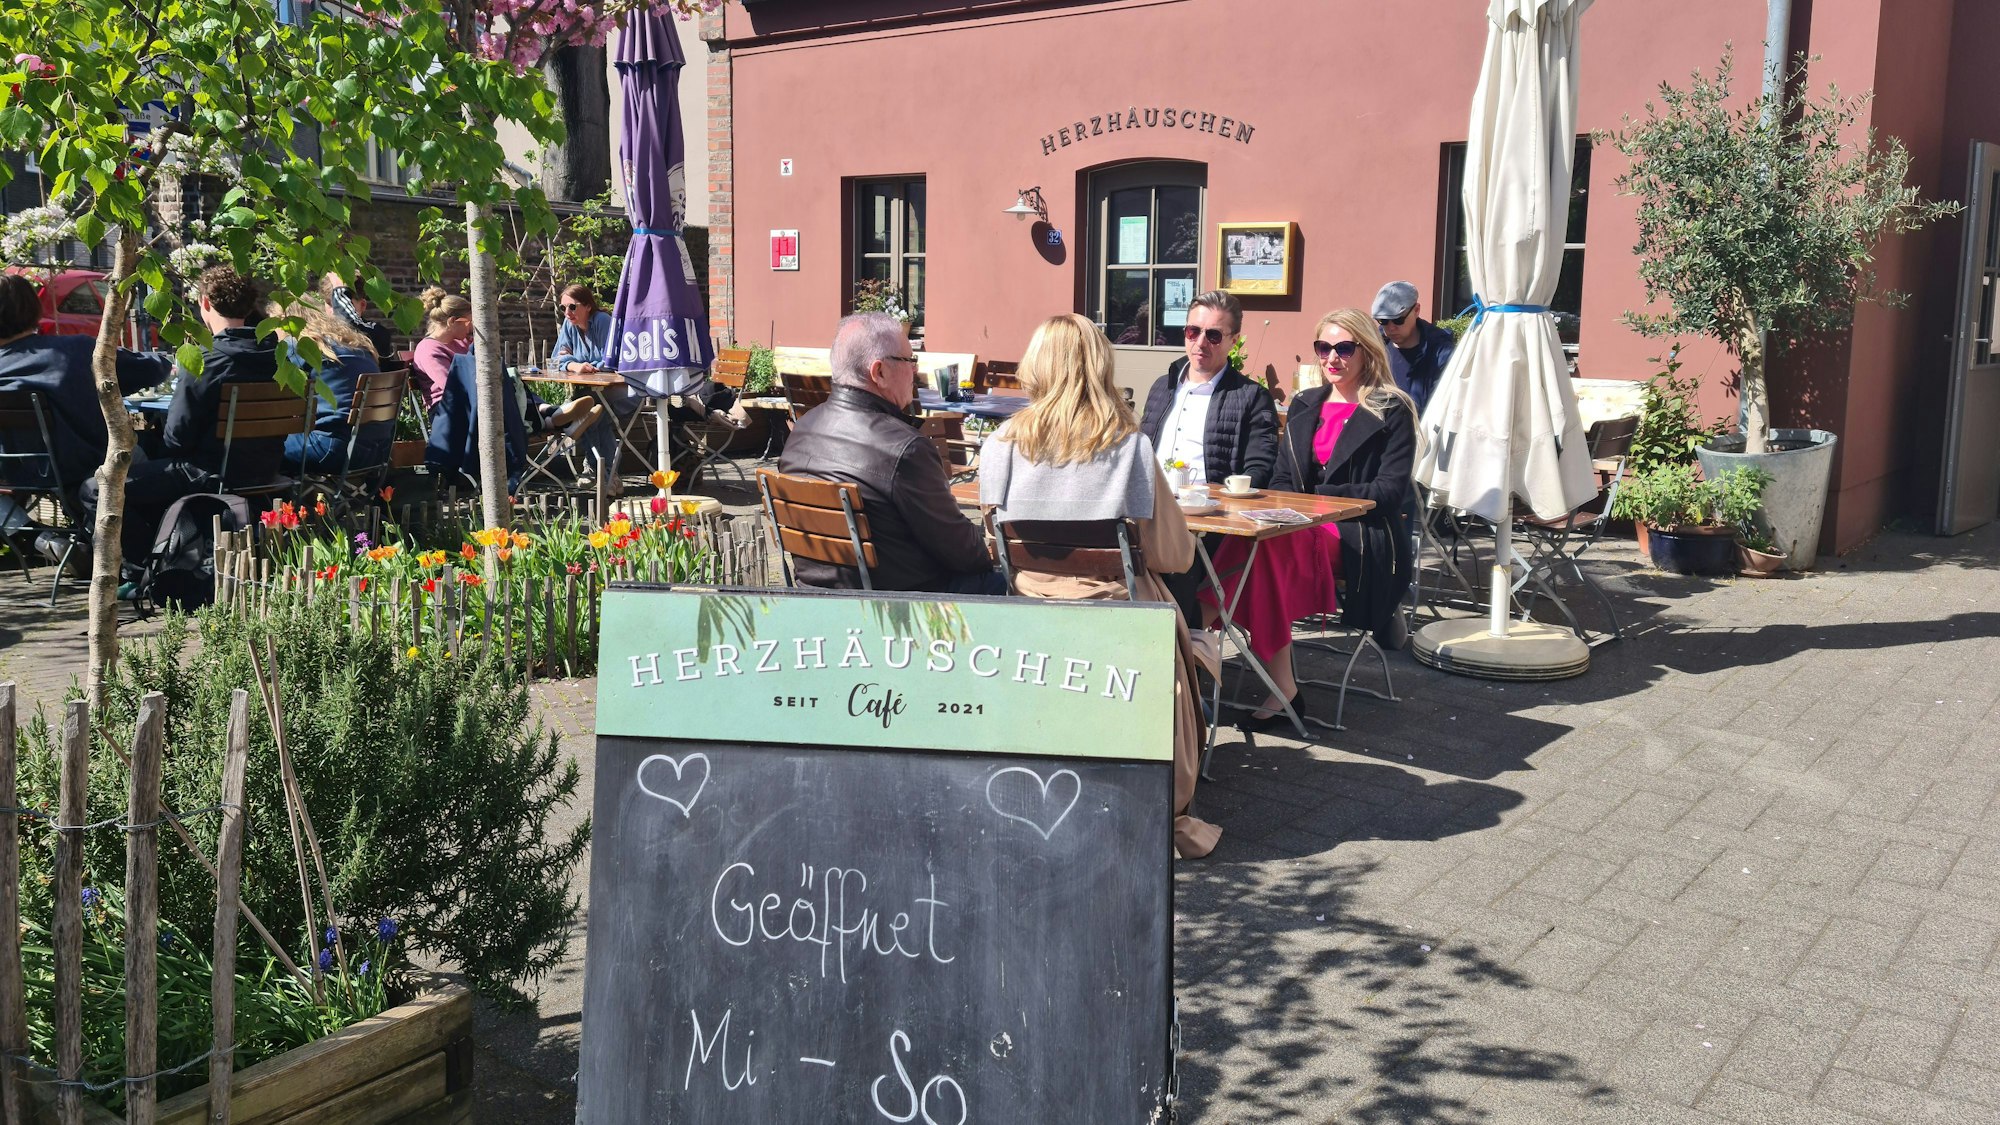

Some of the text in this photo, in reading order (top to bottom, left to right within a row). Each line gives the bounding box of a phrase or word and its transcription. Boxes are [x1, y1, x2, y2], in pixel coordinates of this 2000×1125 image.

[1040, 105, 1255, 156] HERZHÄUSCHEN
[1048, 231, 1060, 243] 32
[627, 628, 1142, 702] HERZHÄUSCHEN
[773, 682, 984, 729] SEIT Café 2021
[711, 862, 955, 983] Geöffnet
[684, 1009, 757, 1091] Mi
[870, 1030, 967, 1125] So
